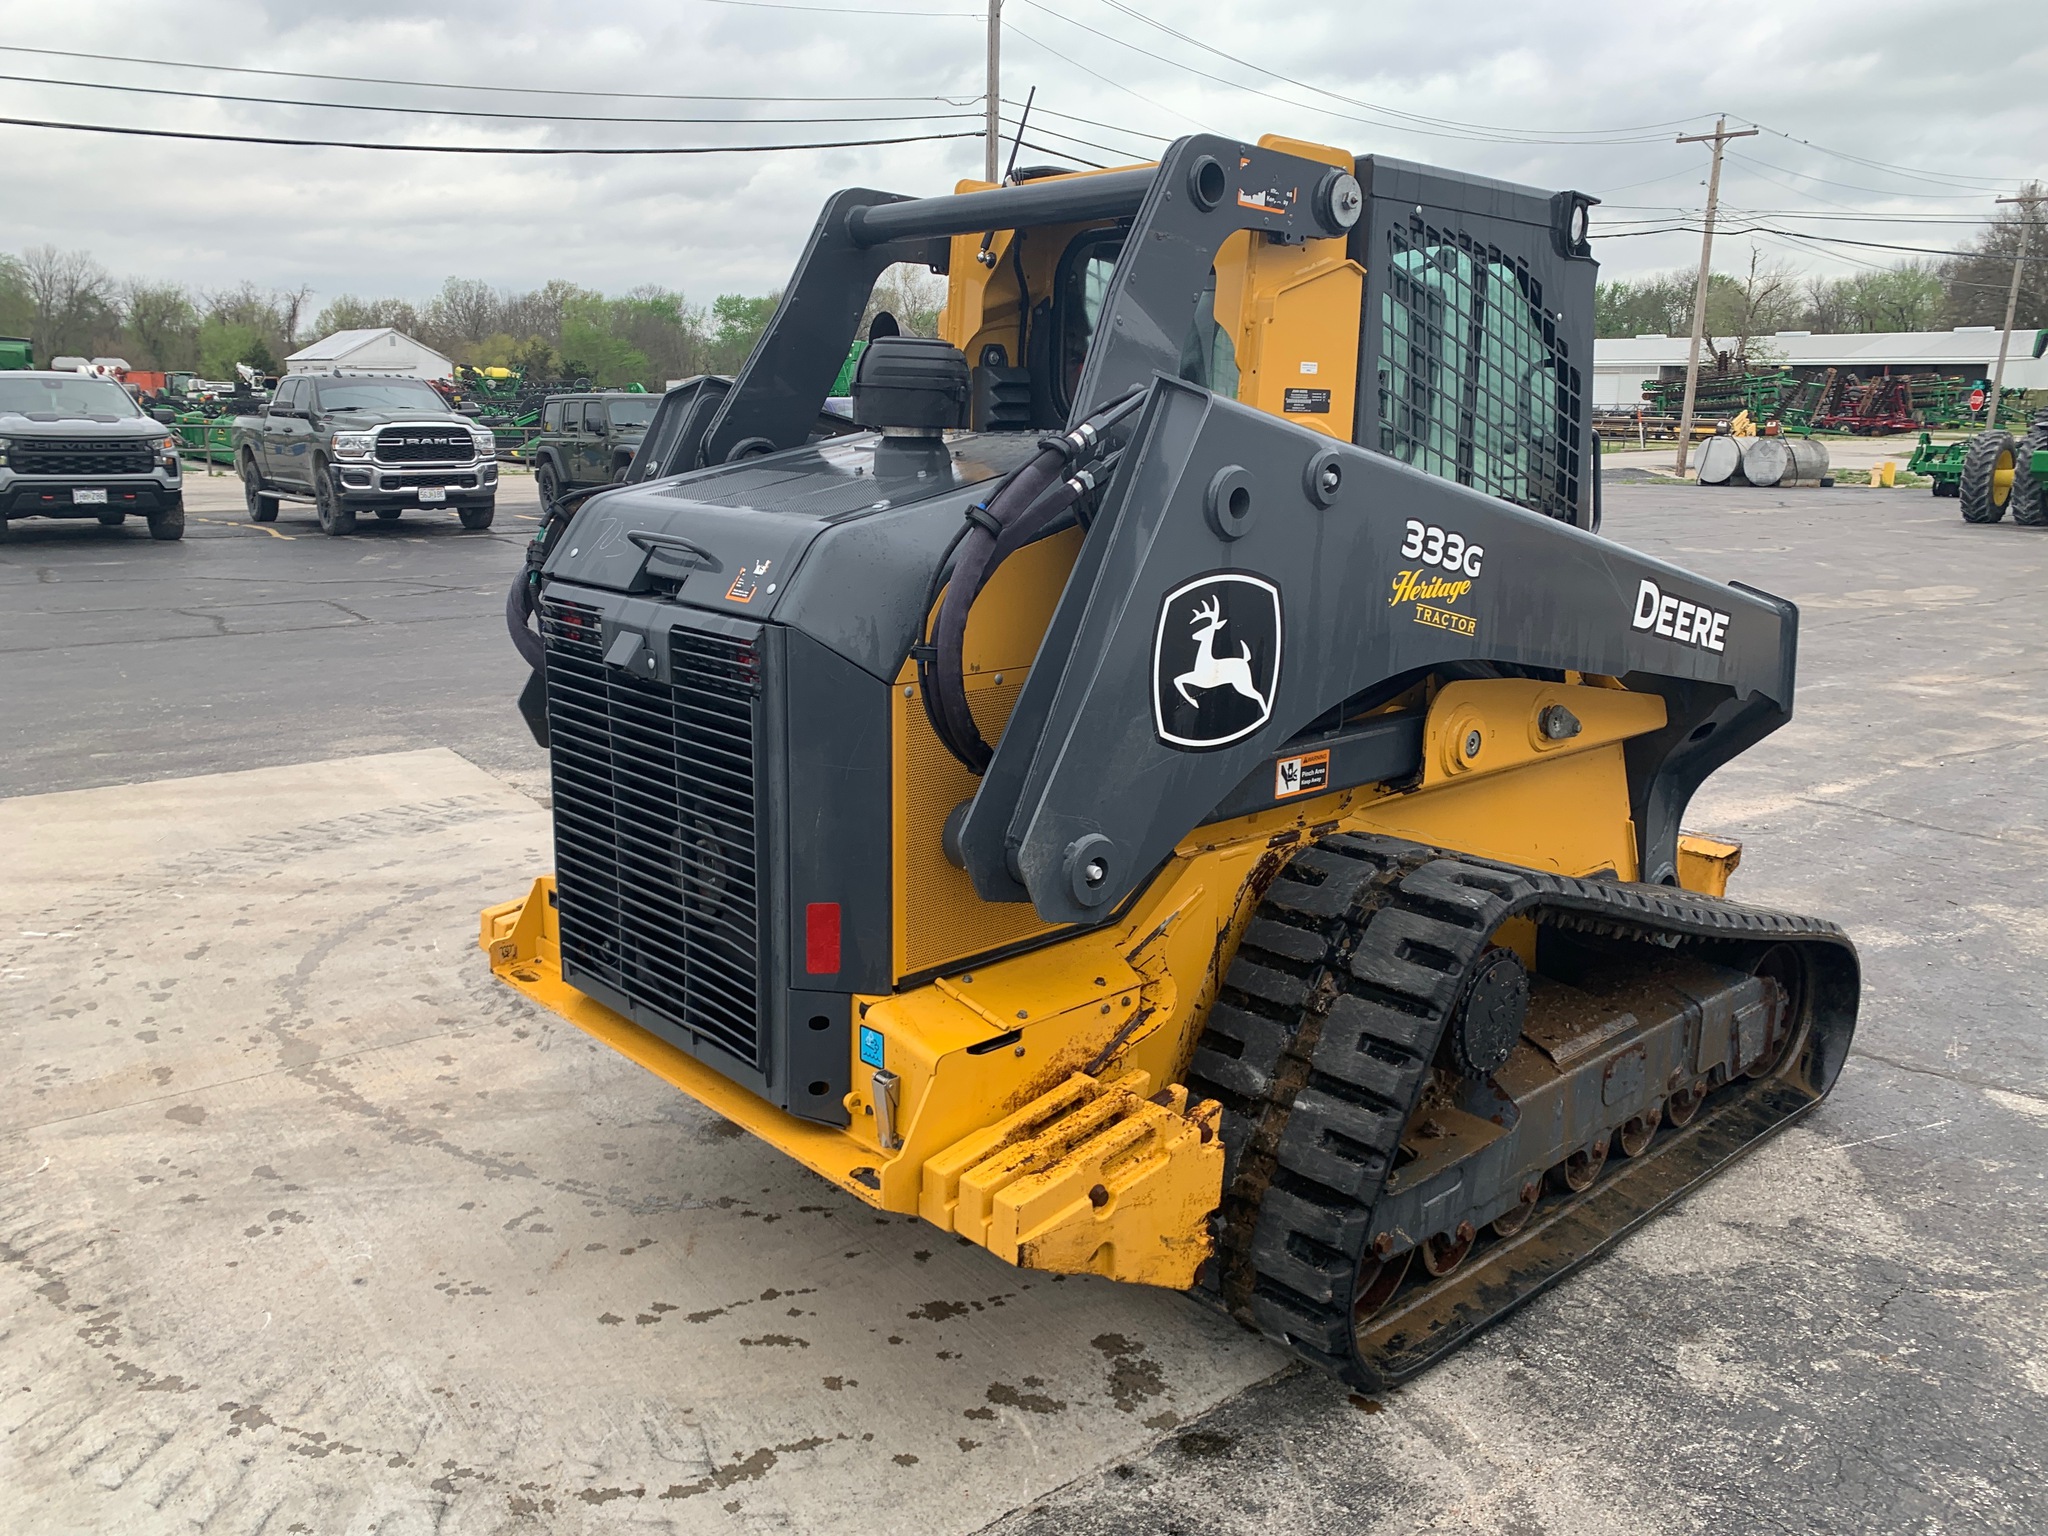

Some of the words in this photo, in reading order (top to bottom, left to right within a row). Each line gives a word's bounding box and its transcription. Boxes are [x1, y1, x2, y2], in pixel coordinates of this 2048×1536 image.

[23, 441, 145, 450] CHEVROLET
[1401, 519, 1484, 578] 333G
[1390, 569, 1472, 607] Heritage
[1416, 606, 1476, 633] TRACTOR
[1632, 579, 1730, 652] DEERE
